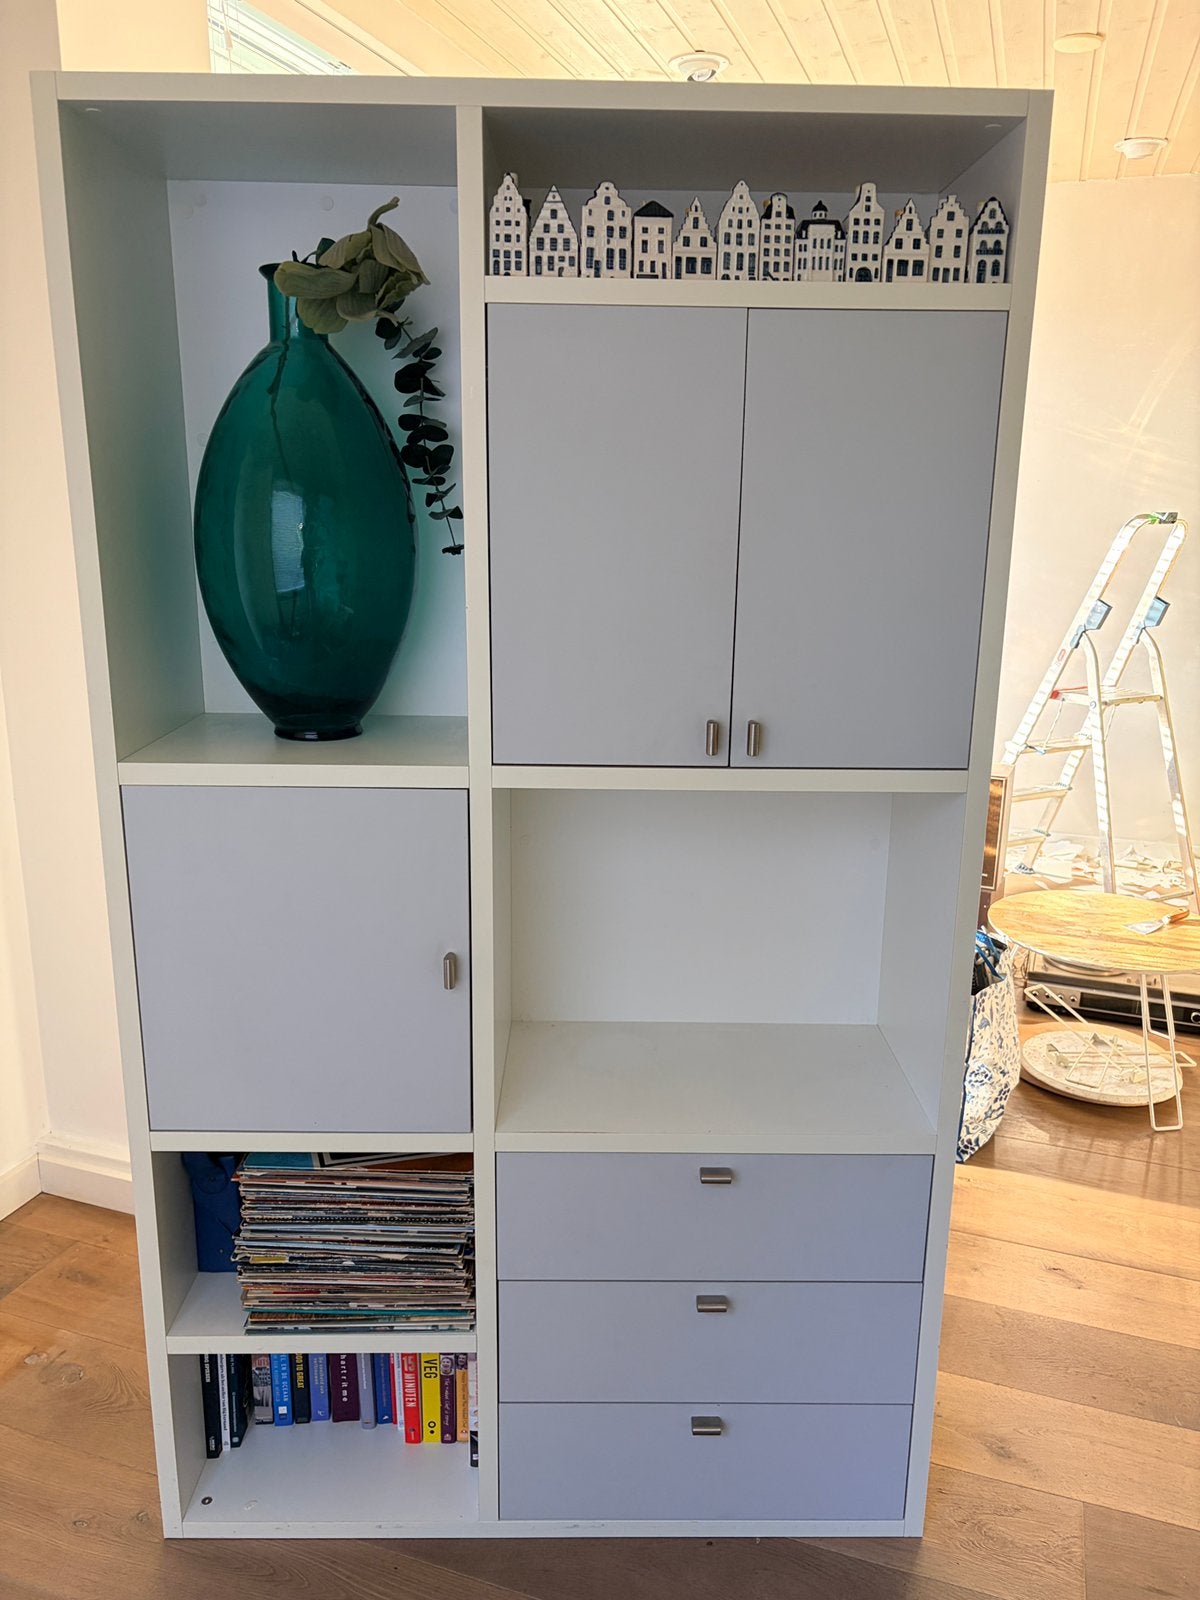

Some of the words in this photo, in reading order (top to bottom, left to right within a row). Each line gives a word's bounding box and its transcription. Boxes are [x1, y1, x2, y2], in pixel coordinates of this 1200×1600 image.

[424, 1358, 438, 1379] VEG
[296, 1372, 304, 1388] GREAT
[404, 1373, 417, 1407] MINUTEN
